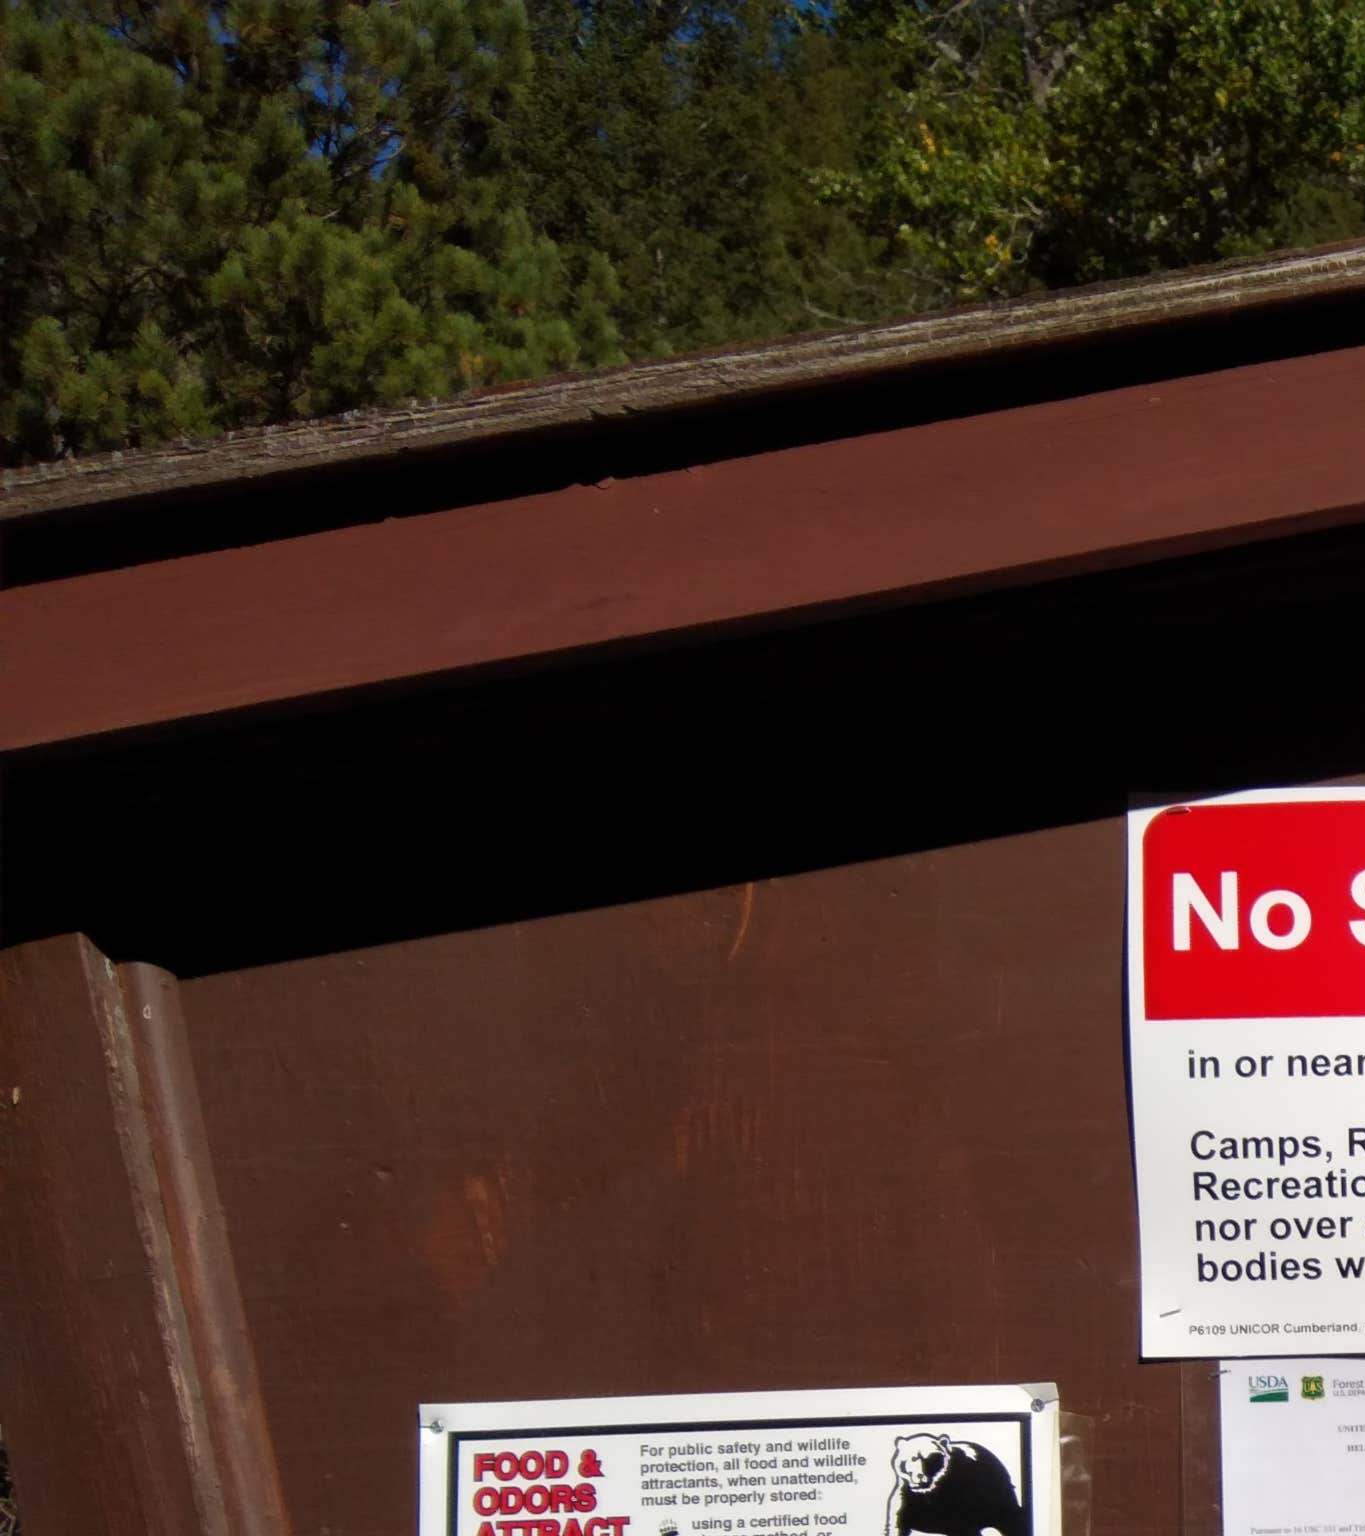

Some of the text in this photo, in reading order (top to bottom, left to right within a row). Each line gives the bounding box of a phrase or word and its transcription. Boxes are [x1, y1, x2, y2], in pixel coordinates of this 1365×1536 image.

[1173, 871, 1311, 951] No
[1189, 1050, 1220, 1078] in
[1235, 1056, 1273, 1078] or
[1191, 1130, 1332, 1166] Camps,
[1196, 1219, 1257, 1241] nor
[1270, 1217, 1353, 1240] over
[1197, 1251, 1322, 1282] bodies
[1189, 1325, 1226, 1335] P6109
[1230, 1324, 1279, 1335] UNICOR
[1249, 1376, 1288, 1390] USDA
[1332, 1379, 1364, 1389] Forest
[640, 1438, 850, 1459] For public safety and wildlife
[474, 1449, 604, 1481] FOOD &
[473, 1483, 597, 1516] ODORS
